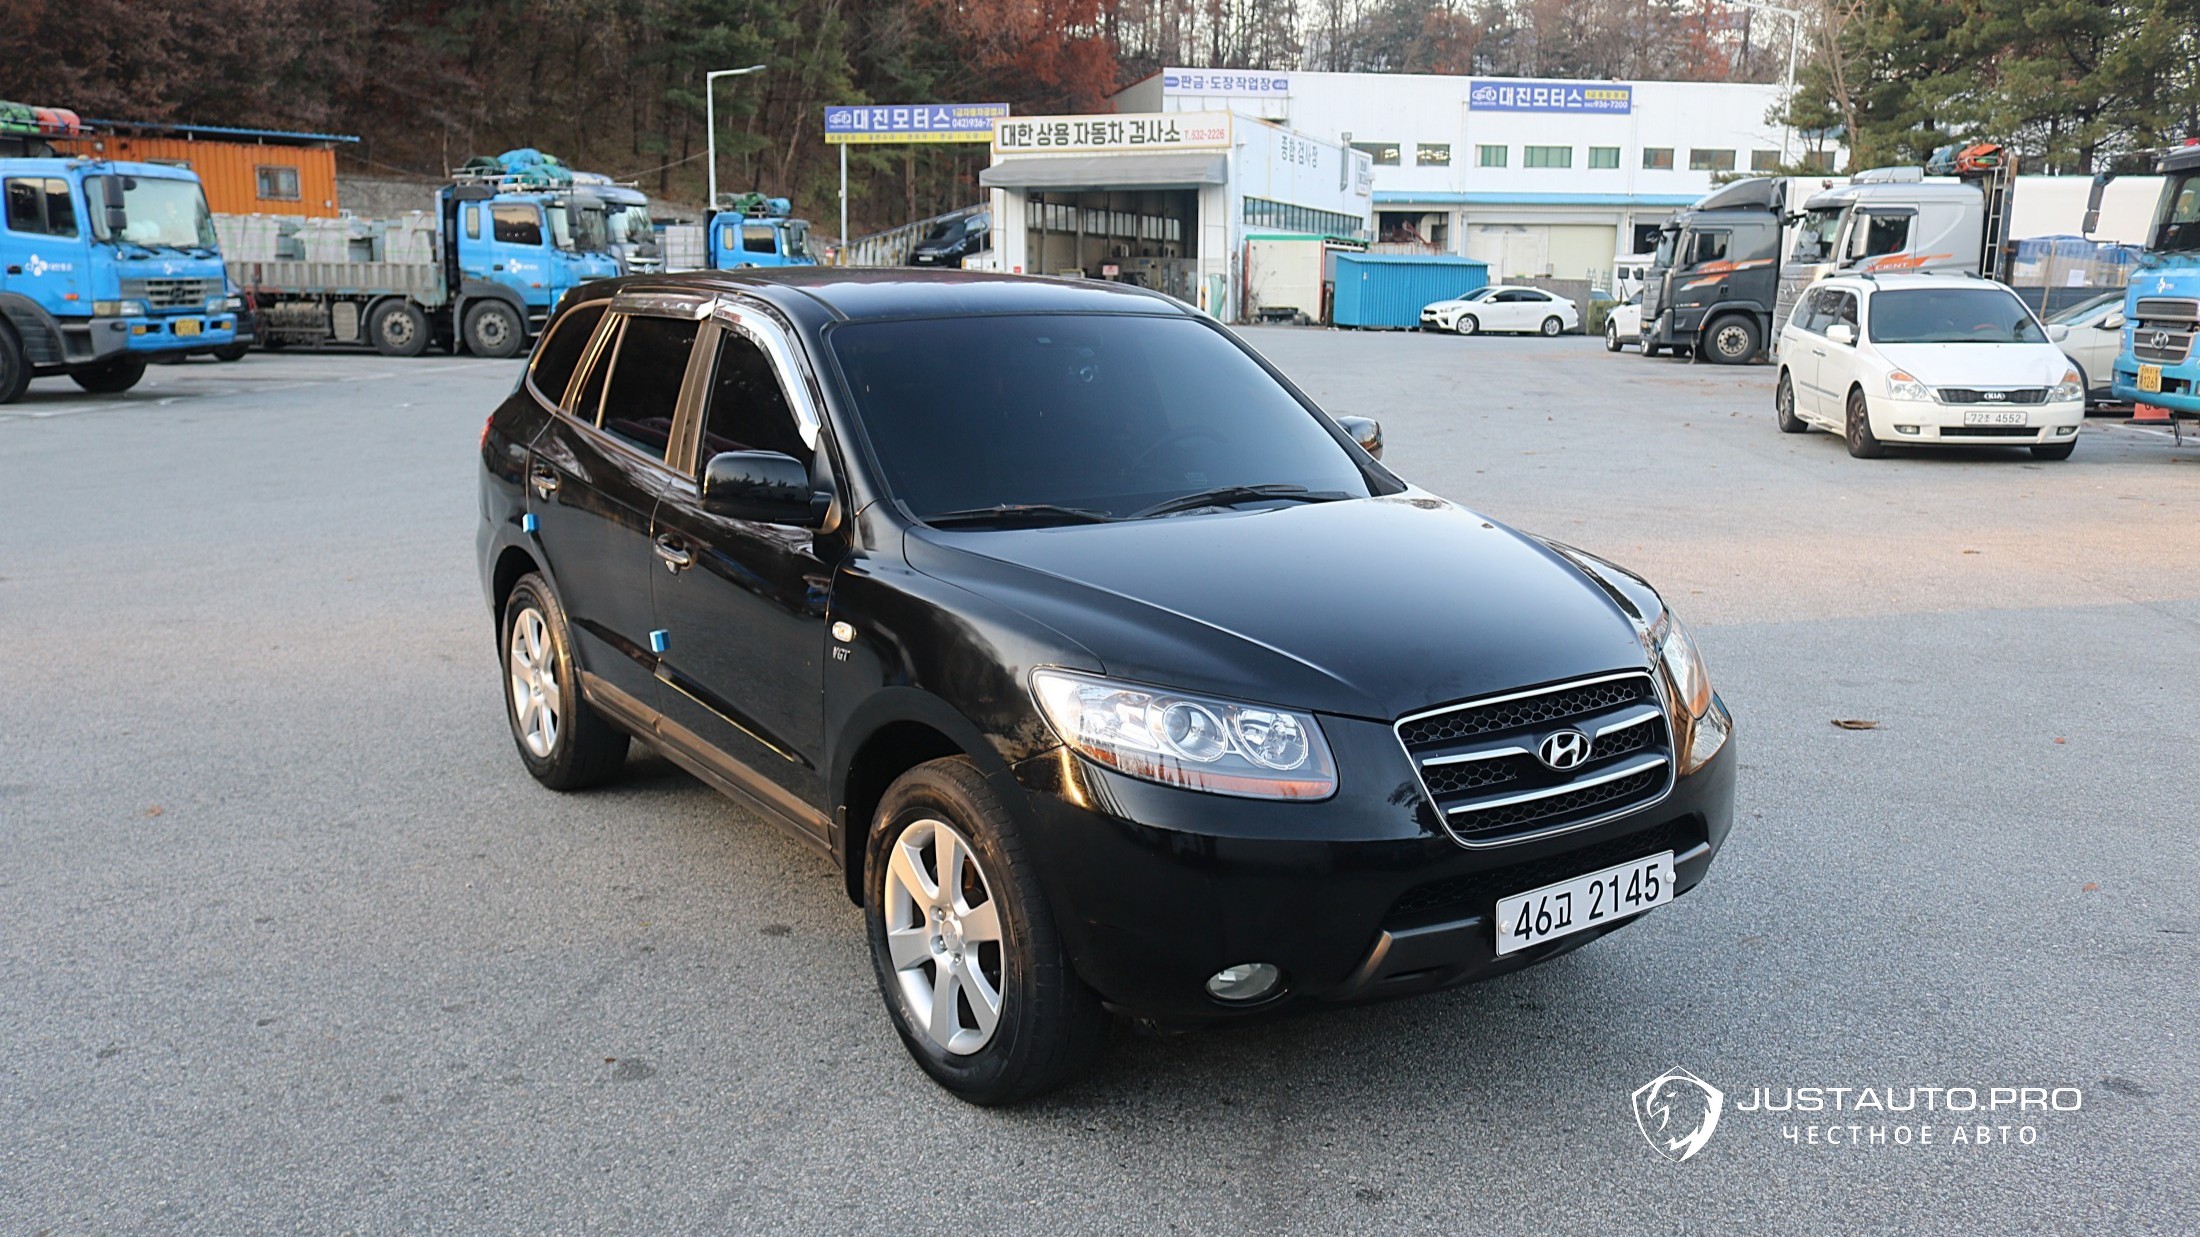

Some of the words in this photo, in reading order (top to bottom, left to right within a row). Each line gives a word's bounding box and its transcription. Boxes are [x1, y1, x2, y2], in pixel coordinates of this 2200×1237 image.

[1499, 86, 1582, 108] 대진모터스
[853, 108, 950, 130] 대진모터스
[1000, 123, 1033, 147] 대한
[1037, 122, 1069, 147] 상용
[1074, 120, 1124, 145] 자동차
[1129, 119, 1181, 144] 검사소
[1995, 413, 2021, 423] 4552
[832, 646, 851, 662] VGT
[1513, 891, 1572, 941] 46고
[1588, 863, 1660, 921] 2145
